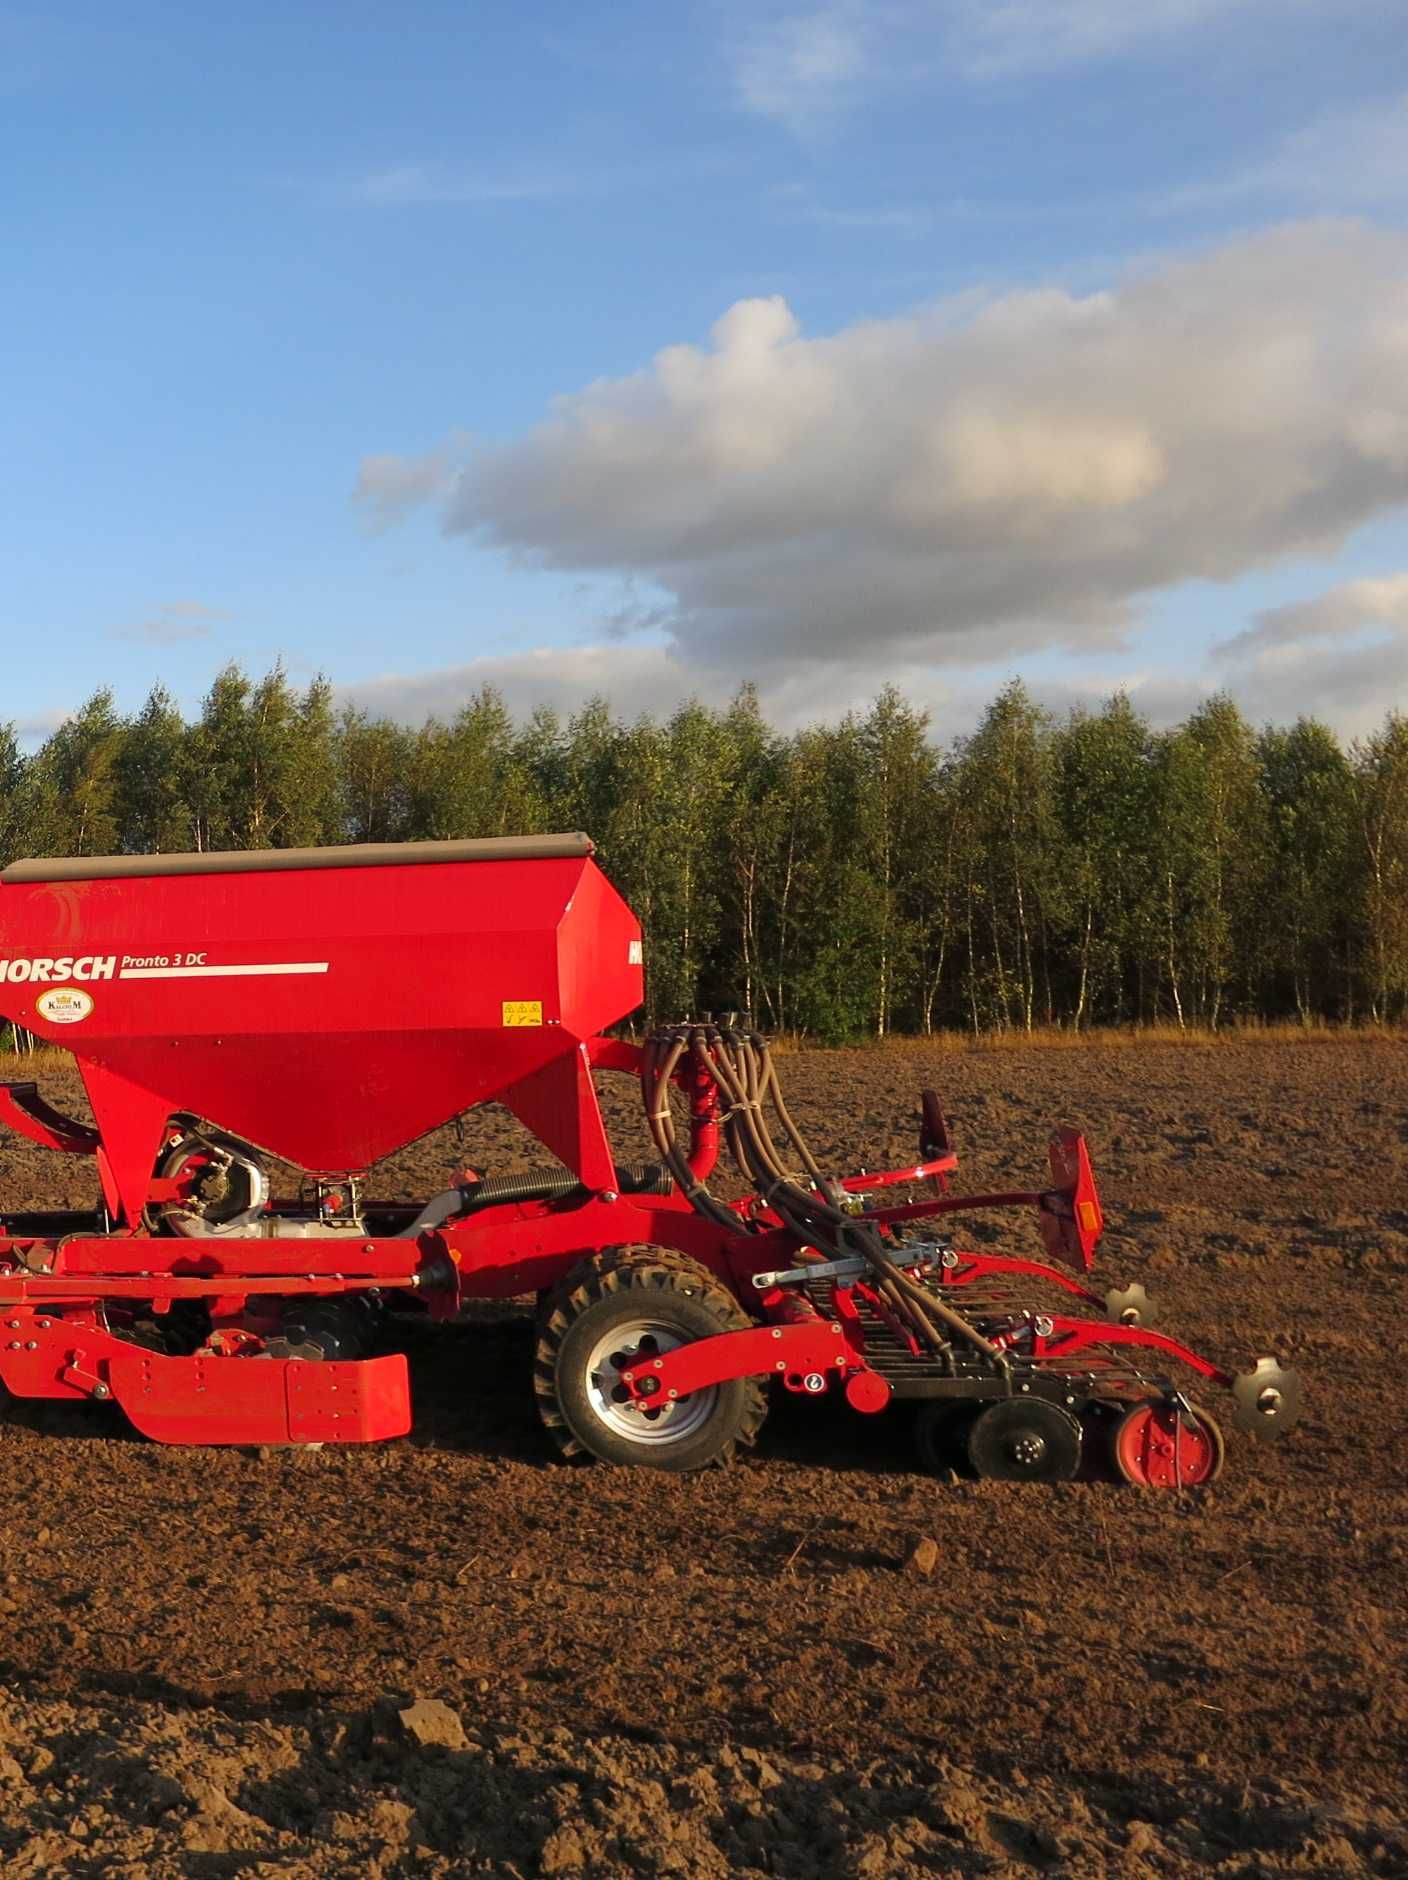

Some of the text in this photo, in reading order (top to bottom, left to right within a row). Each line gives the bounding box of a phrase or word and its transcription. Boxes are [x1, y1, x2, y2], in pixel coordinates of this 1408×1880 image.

[121, 952, 207, 968] Pronto 3 DC
